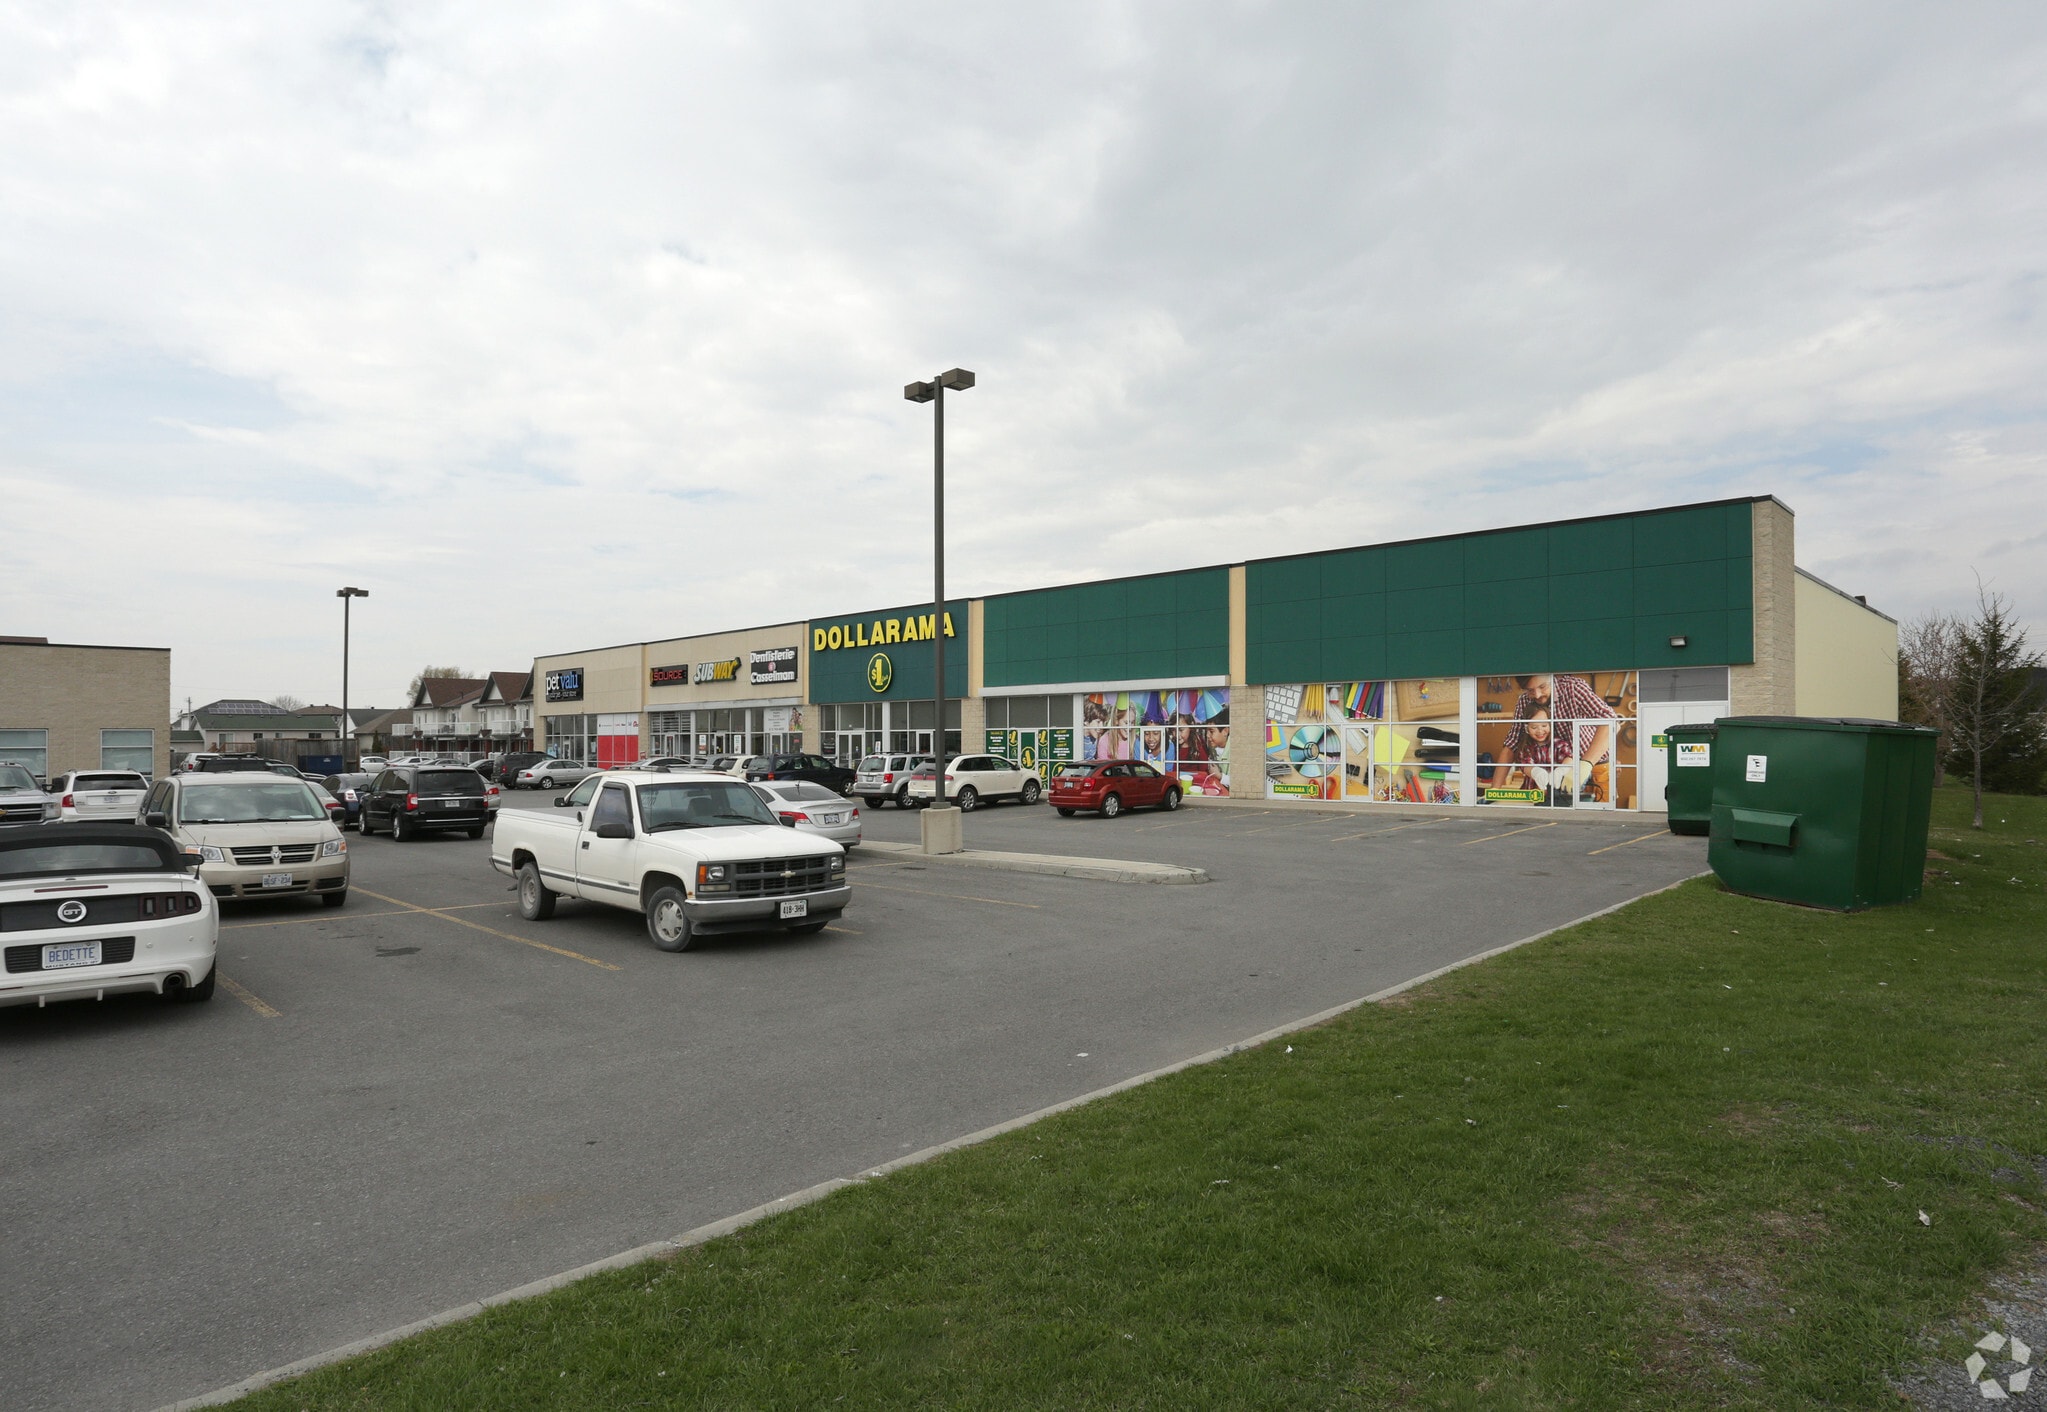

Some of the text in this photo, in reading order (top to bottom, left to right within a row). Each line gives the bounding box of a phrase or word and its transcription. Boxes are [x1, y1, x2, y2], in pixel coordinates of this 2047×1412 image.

[814, 612, 955, 651] DOLLARAMA
[653, 670, 683, 681] SOURCE
[693, 660, 739, 682] SUBWAY
[751, 671, 795, 683] Casselman
[546, 673, 559, 696] pet
[560, 671, 579, 689] valu
[1487, 791, 1527, 799] DOLLARAMA
[63, 908, 81, 916] GT
[48, 946, 96, 963] BEDETTE
